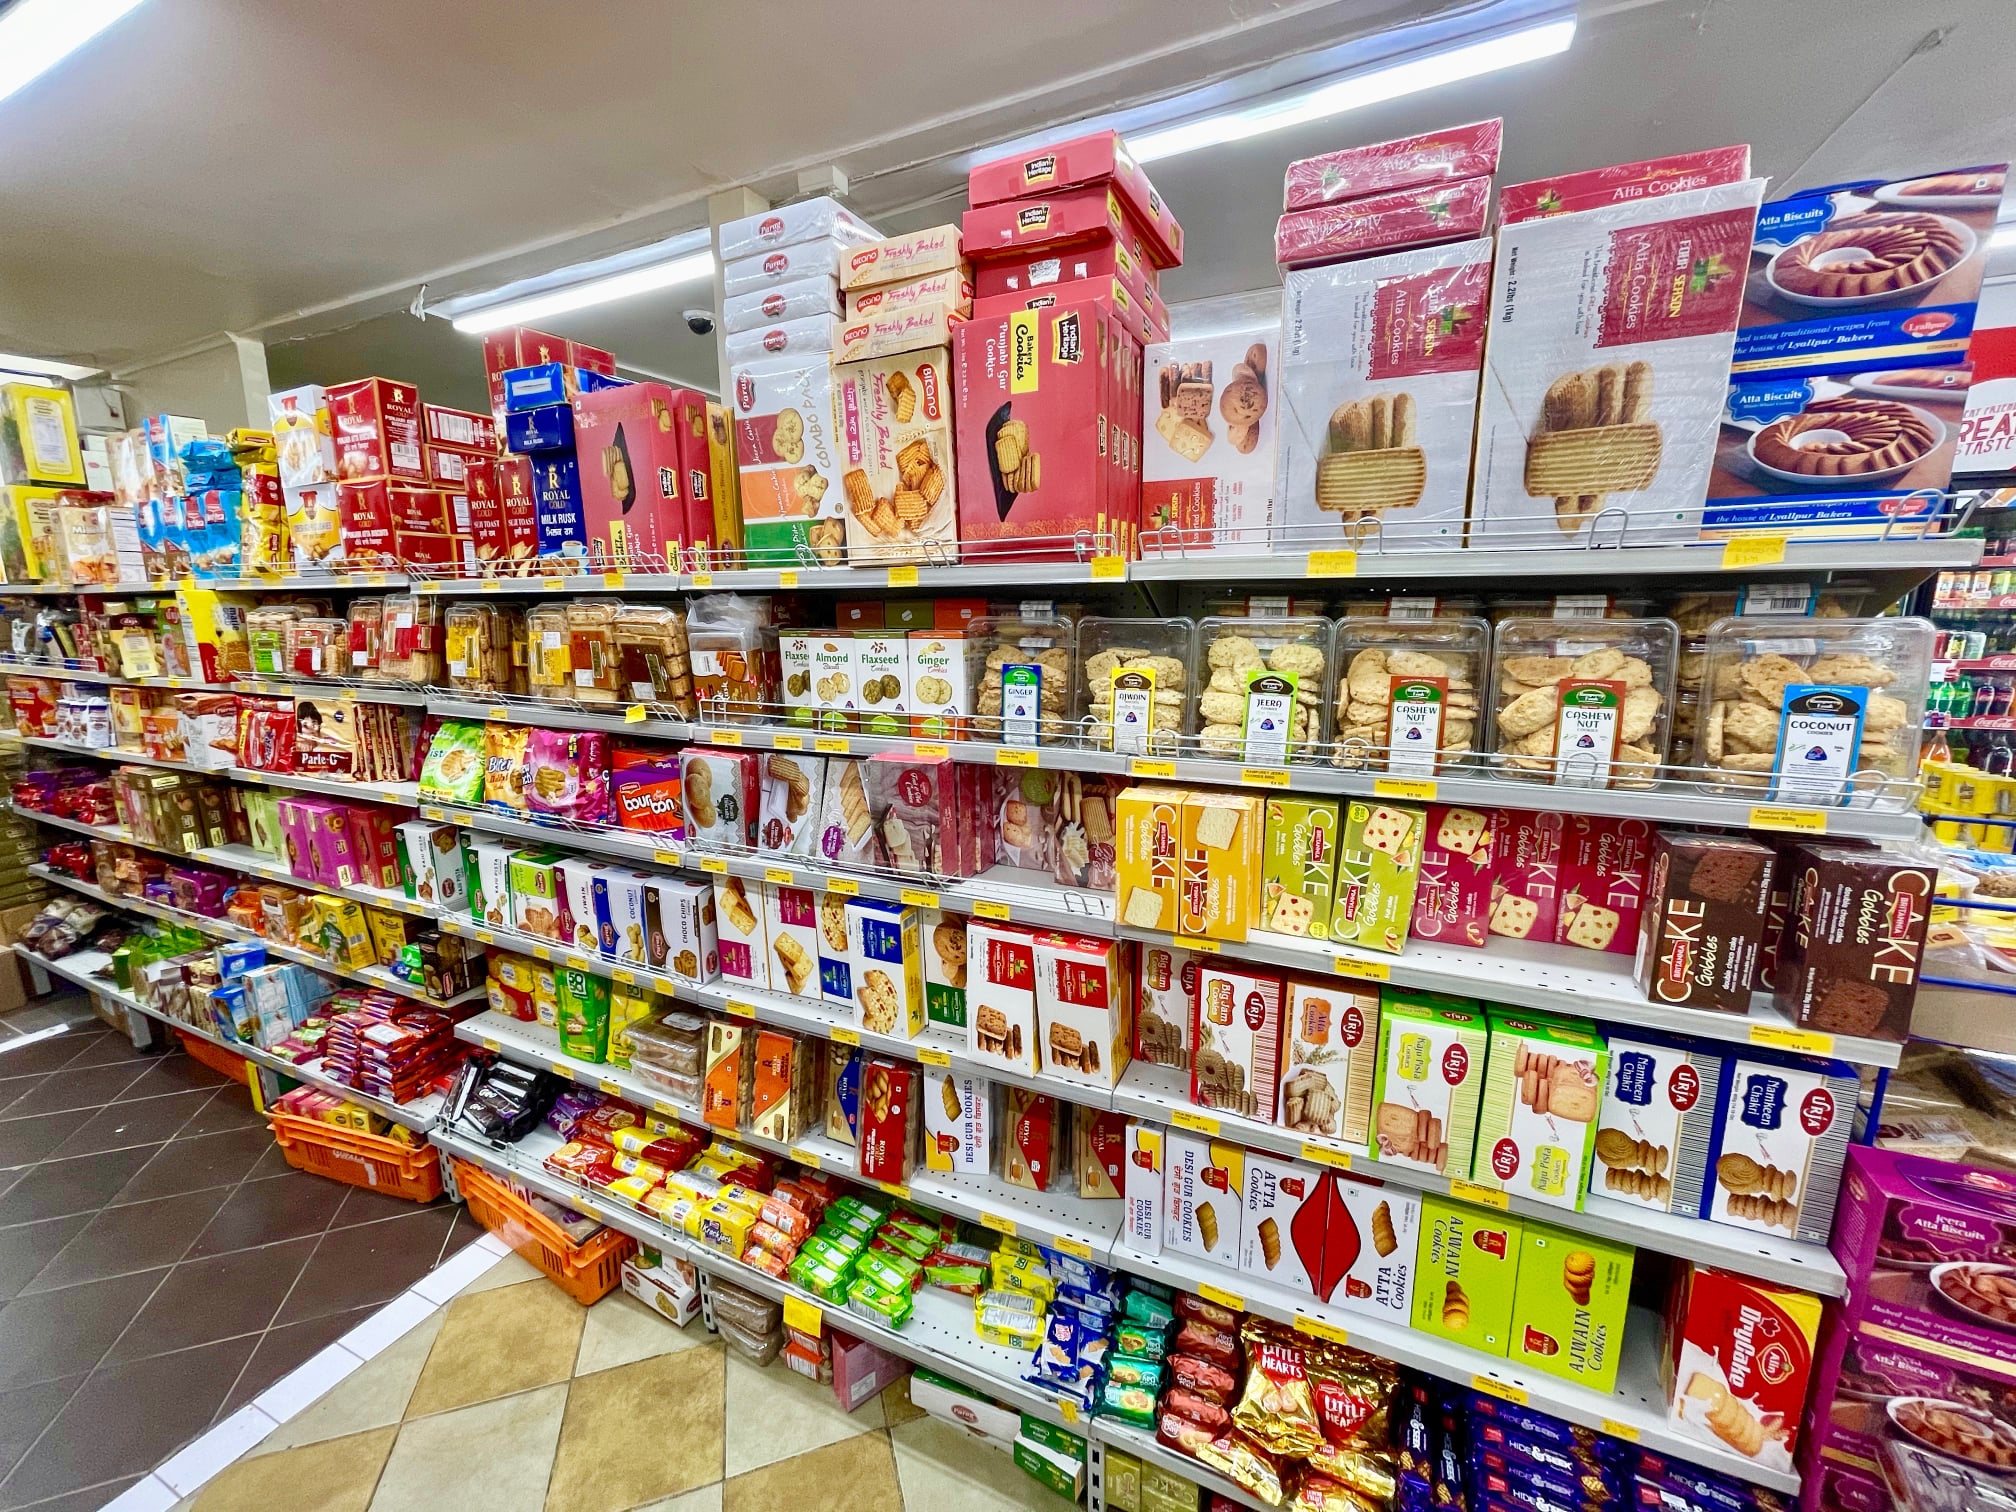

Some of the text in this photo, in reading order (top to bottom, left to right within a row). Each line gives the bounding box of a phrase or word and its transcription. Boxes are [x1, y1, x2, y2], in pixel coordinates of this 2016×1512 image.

[1029, 158, 1050, 170] Indian
[1612, 174, 1708, 201] Atta Cookies
[1023, 208, 1043, 218] Indian
[1759, 207, 1824, 226] Atta Biscuits
[1625, 270, 1648, 331] Cookies
[997, 321, 1009, 365] Punjabi
[1058, 319, 1071, 361] Heritage
[1068, 321, 1079, 352] Indian
[1391, 289, 1407, 365] Atta Cookies
[1788, 336, 1834, 350] Lyallpur
[1837, 333, 1874, 345] Bakers
[986, 338, 997, 379] Cookies
[1014, 323, 1028, 381] Cookies
[1025, 335, 1035, 365] Bakery
[1740, 389, 1802, 403] Atta Biscuits
[810, 411, 832, 469] COMBO
[472, 499, 497, 510] ROYAL
[506, 496, 532, 507] ROYAL
[542, 490, 570, 501] ROYAL
[353, 511, 376, 520] ROYAL
[541, 512, 576, 525] MILK RUSK
[1770, 511, 1814, 523] Lyallpur
[1817, 509, 1852, 520] Bakers
[816, 652, 849, 663] Almond
[861, 654, 899, 664] Flaxseed
[917, 654, 950, 667] Ginger
[1008, 688, 1033, 696] GINGER
[1256, 698, 1282, 709] JEERA
[1396, 704, 1438, 715] CASHEW
[1406, 713, 1426, 722] NUT
[1565, 710, 1613, 721] CASHEW
[1576, 719, 1600, 729] NUT
[1790, 720, 1853, 732] COCONUT
[301, 752, 337, 766] Parle-G
[1139, 819, 1151, 861] Gobbles
[1156, 821, 1168, 856] BRITANNIA
[1292, 823, 1307, 867] Gobbles
[1311, 825, 1326, 862] BRITANNIA
[1516, 825, 1533, 869] Gobbles
[1536, 827, 1552, 863] BRITANNIA
[1596, 832, 1616, 877] Gobbles
[629, 886, 638, 921] COCONUT
[1191, 881, 1203, 917] BRITANNIA
[1207, 877, 1220, 920] Gobbles
[1345, 885, 1359, 921] BRITANNIA
[1363, 881, 1381, 928] Gobbles
[1426, 885, 1438, 920] BRITANNIA
[1443, 880, 1461, 924] Gobbles
[1887, 891, 1914, 940] BRITANNIA
[1856, 888, 1885, 945] Gobbles
[1159, 953, 1173, 989] Big Jam
[1669, 940, 1691, 984] BRITANNIA
[1695, 934, 1719, 988] Gobbles
[1219, 983, 1231, 1023] Big Jam
[1412, 1058, 1425, 1081] Pista
[1621, 1061, 1635, 1093] Chakri
[1632, 1056, 1649, 1103] Namkeen
[1747, 1084, 1764, 1116] Chakri
[1760, 1078, 1781, 1127] Namkeen
[965, 1079, 974, 1163] DESI GUR COOKIES
[1022, 1119, 1031, 1147] ROYAL
[1097, 1124, 1105, 1152] ROYAL
[879, 1139, 887, 1166] ROYAL
[1540, 1147, 1553, 1172] Pista
[1182, 1150, 1195, 1243] DESI GUR COOKIES
[1250, 1167, 1264, 1212] Cookies
[1262, 1170, 1277, 1209] ATTA
[1136, 1199, 1145, 1238] COOKIES
[1143, 1199, 1153, 1240] DESI GUR
[1914, 1219, 1987, 1242] Atta Biscuits
[1935, 1212, 1967, 1229] Jeera
[1430, 1218, 1448, 1265] Cookies
[1445, 1215, 1465, 1278] AJWAIN
[1375, 1265, 1392, 1307] ATTA
[1390, 1263, 1408, 1310] Cookies
[1262, 1344, 1302, 1364] LITTLE
[1568, 1308, 1592, 1374] AJWAIN
[1588, 1322, 1608, 1373] Cookies
[1177, 1373, 1196, 1387] Good
[1261, 1355, 1303, 1379] HEARTS
[1162, 1415, 1182, 1428] Good
[1324, 1396, 1367, 1420] LITTLE
[1509, 1440, 1574, 1471] HIDE SEEK
[1669, 1471, 1743, 1510] HIDE SEEK
